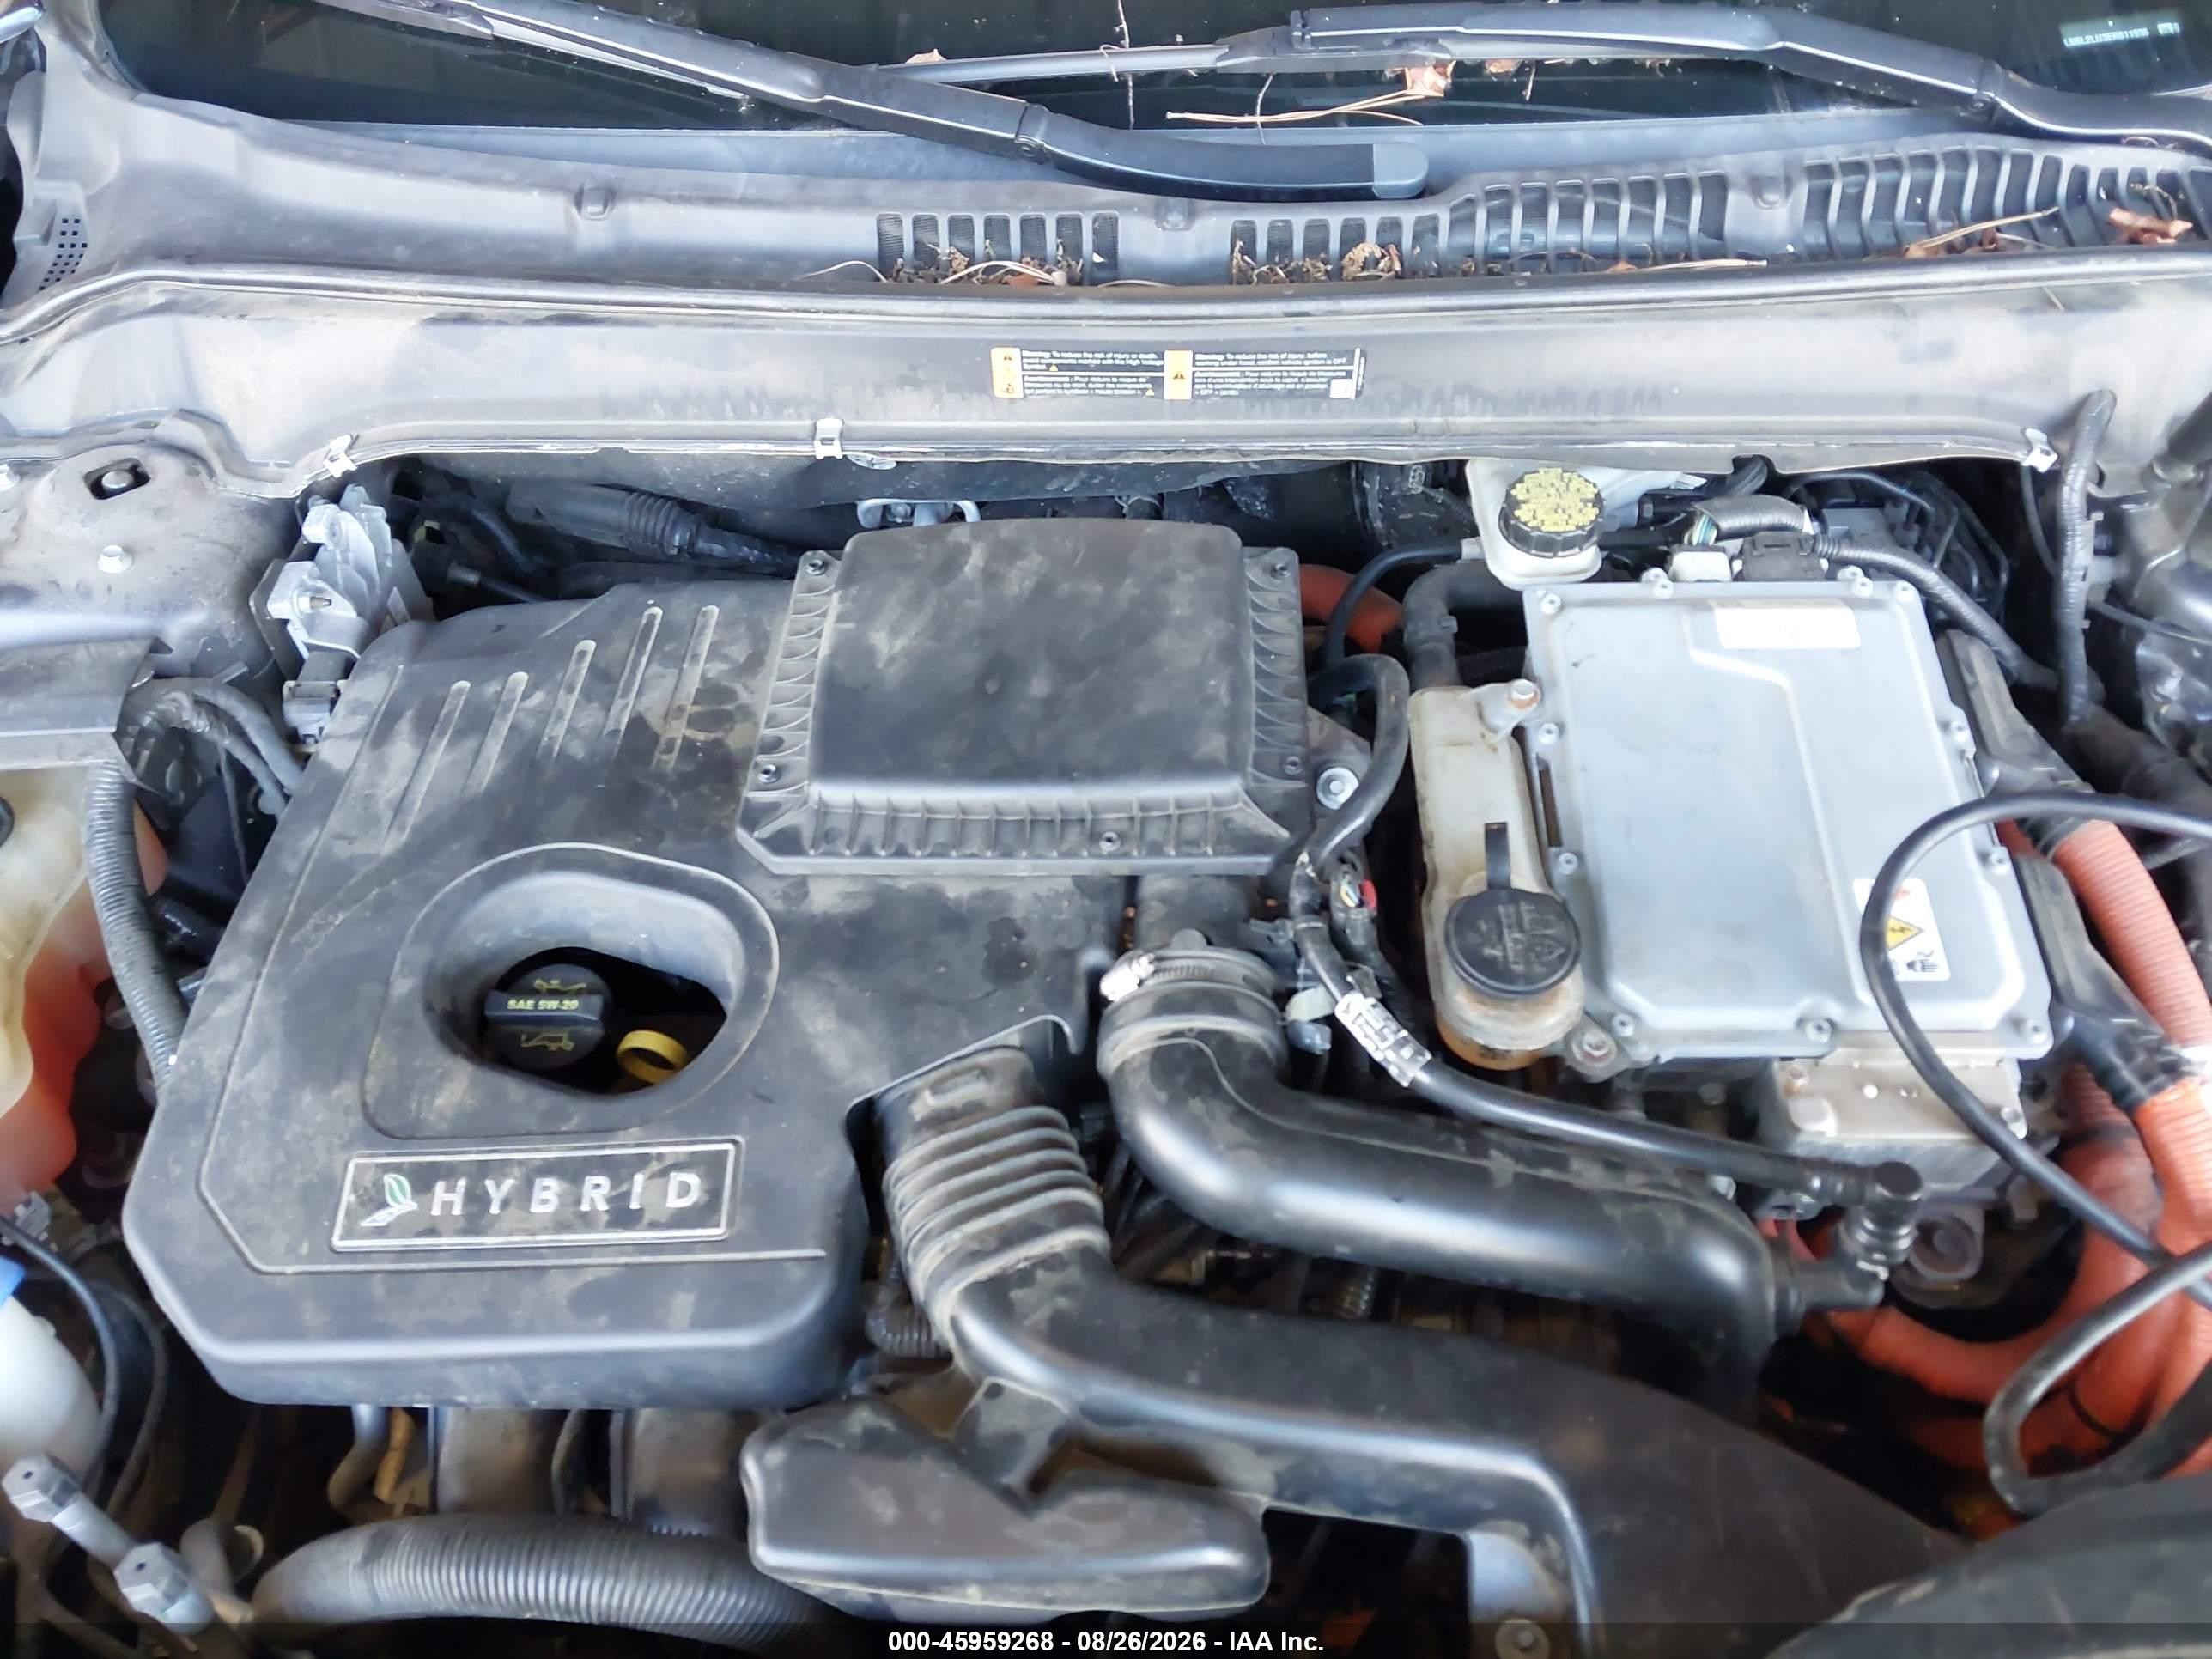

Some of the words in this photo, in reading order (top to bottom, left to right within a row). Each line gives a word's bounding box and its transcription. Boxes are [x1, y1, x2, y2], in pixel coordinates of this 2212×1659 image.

[507, 999, 536, 1011] SAE
[537, 999, 580, 1011] 5W-20
[430, 1171, 703, 1216] HYBRID
